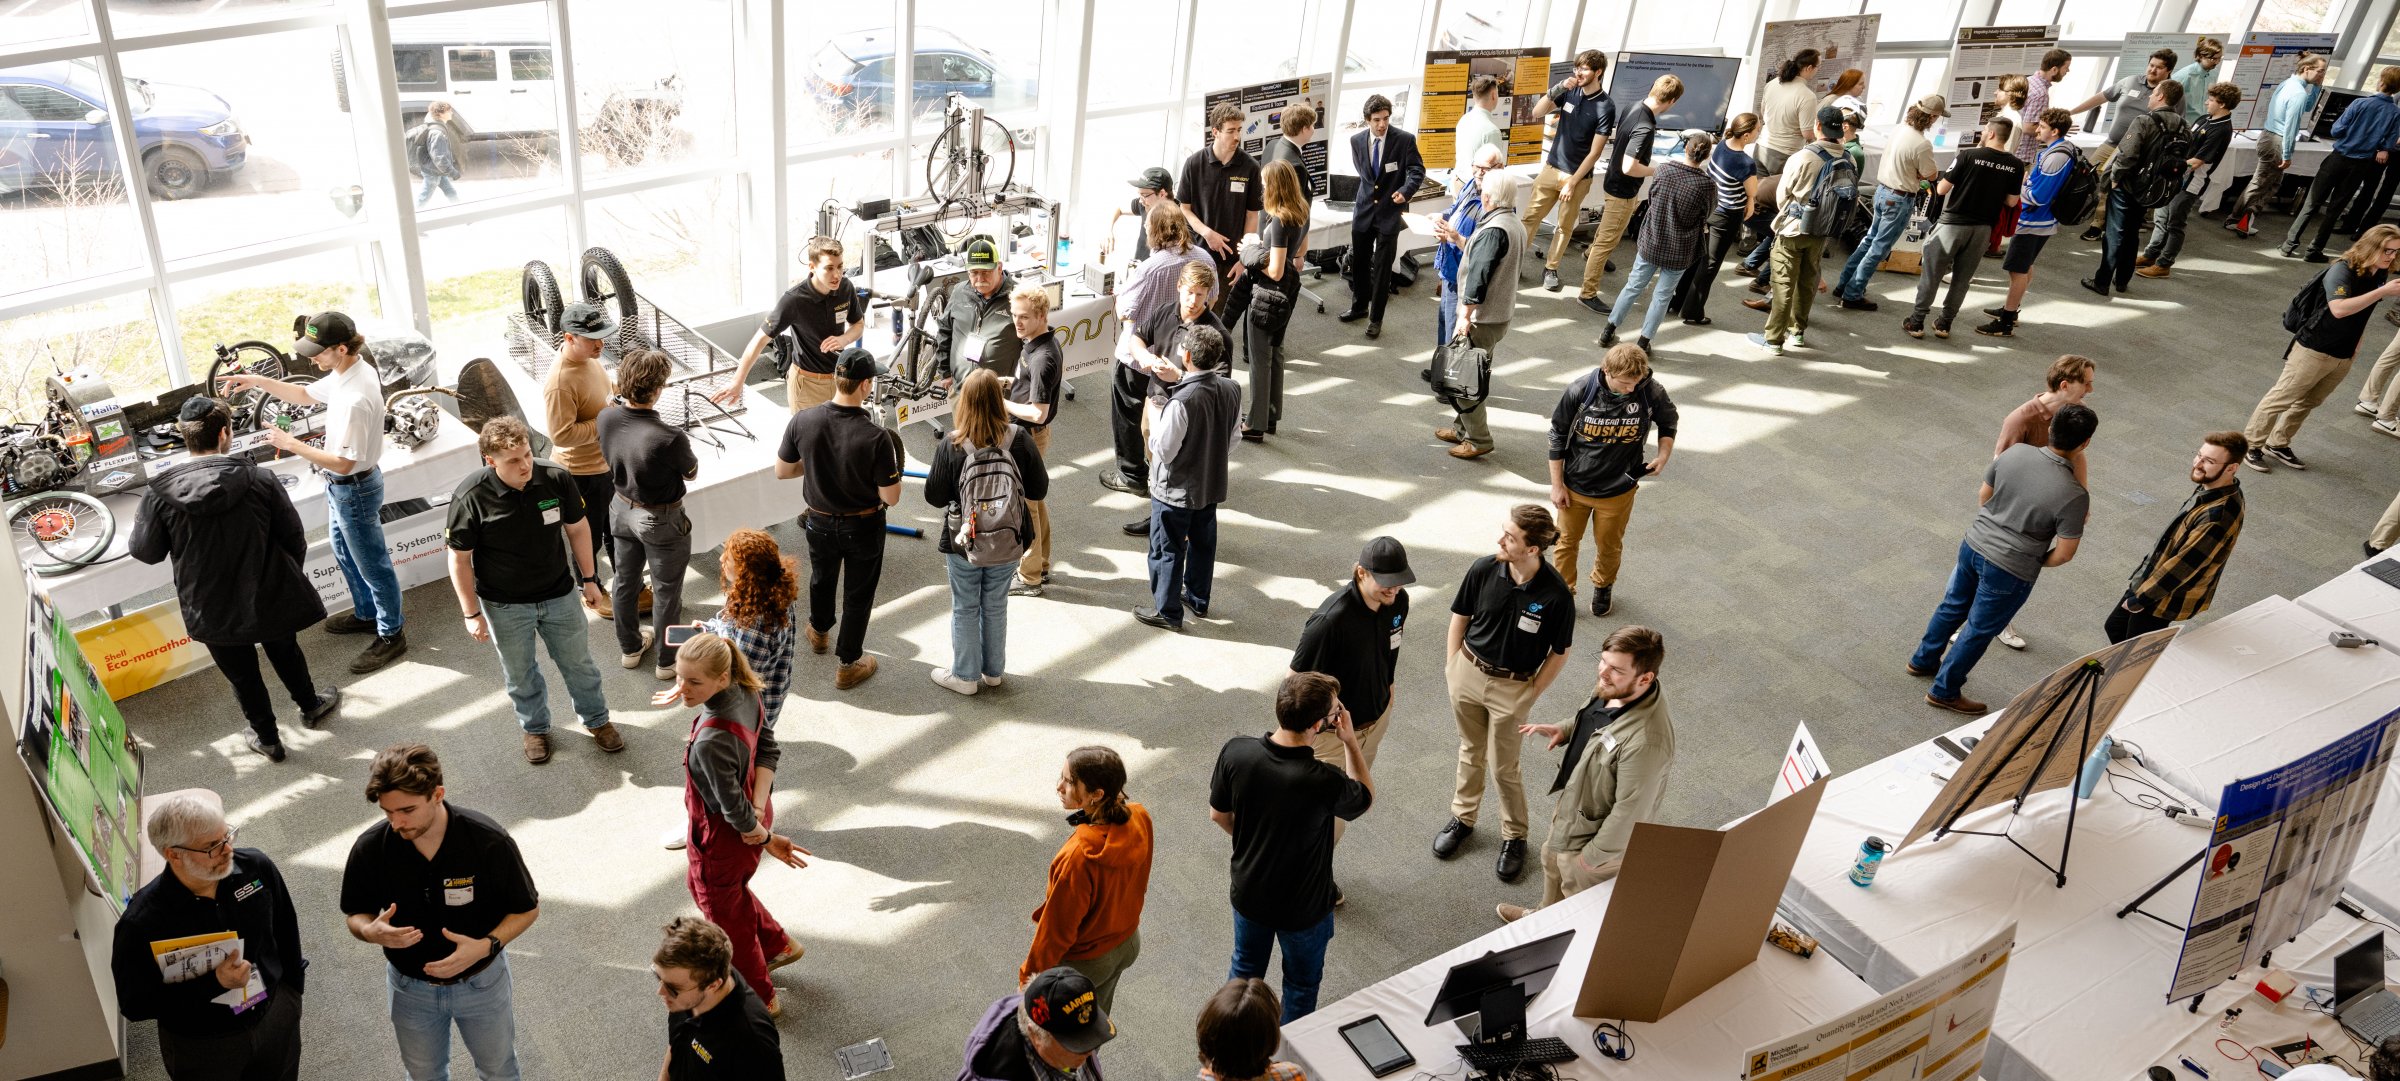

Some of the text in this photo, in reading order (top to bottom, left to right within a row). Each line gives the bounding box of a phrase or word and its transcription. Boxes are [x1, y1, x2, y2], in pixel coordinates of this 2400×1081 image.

[1459, 49, 1480, 57] Network
[1479, 48, 1506, 56] Acquisition
[1974, 158, 1994, 168] WE'RE
[1065, 357, 1109, 372] engineering
[911, 399, 948, 415] Michigan
[1584, 415, 1640, 426] MICHIGAN TECH
[1583, 423, 1640, 437] HUSKIES
[313, 532, 442, 579] Supe Systems
[412, 547, 442, 561] Americas
[316, 581, 335, 592] dway
[322, 591, 345, 603] chigan
[104, 649, 127, 662] Shell
[2239, 778, 2261, 792] Design
[2260, 774, 2273, 785] and
[2272, 762, 2306, 782] Development
[1062, 991, 1094, 1015] MARINES
[1816, 1018, 1857, 1042] Quantifying
[1857, 1009, 1875, 1023] Head
[1875, 1002, 1889, 1014] and
[1888, 996, 1904, 1009] Neck
[1905, 981, 1937, 1001] Movement
[1770, 1043, 1798, 1057] Michigan
[1770, 1043, 1810, 1063] Technological
[1781, 1057, 1820, 1078] ABSTRACT
